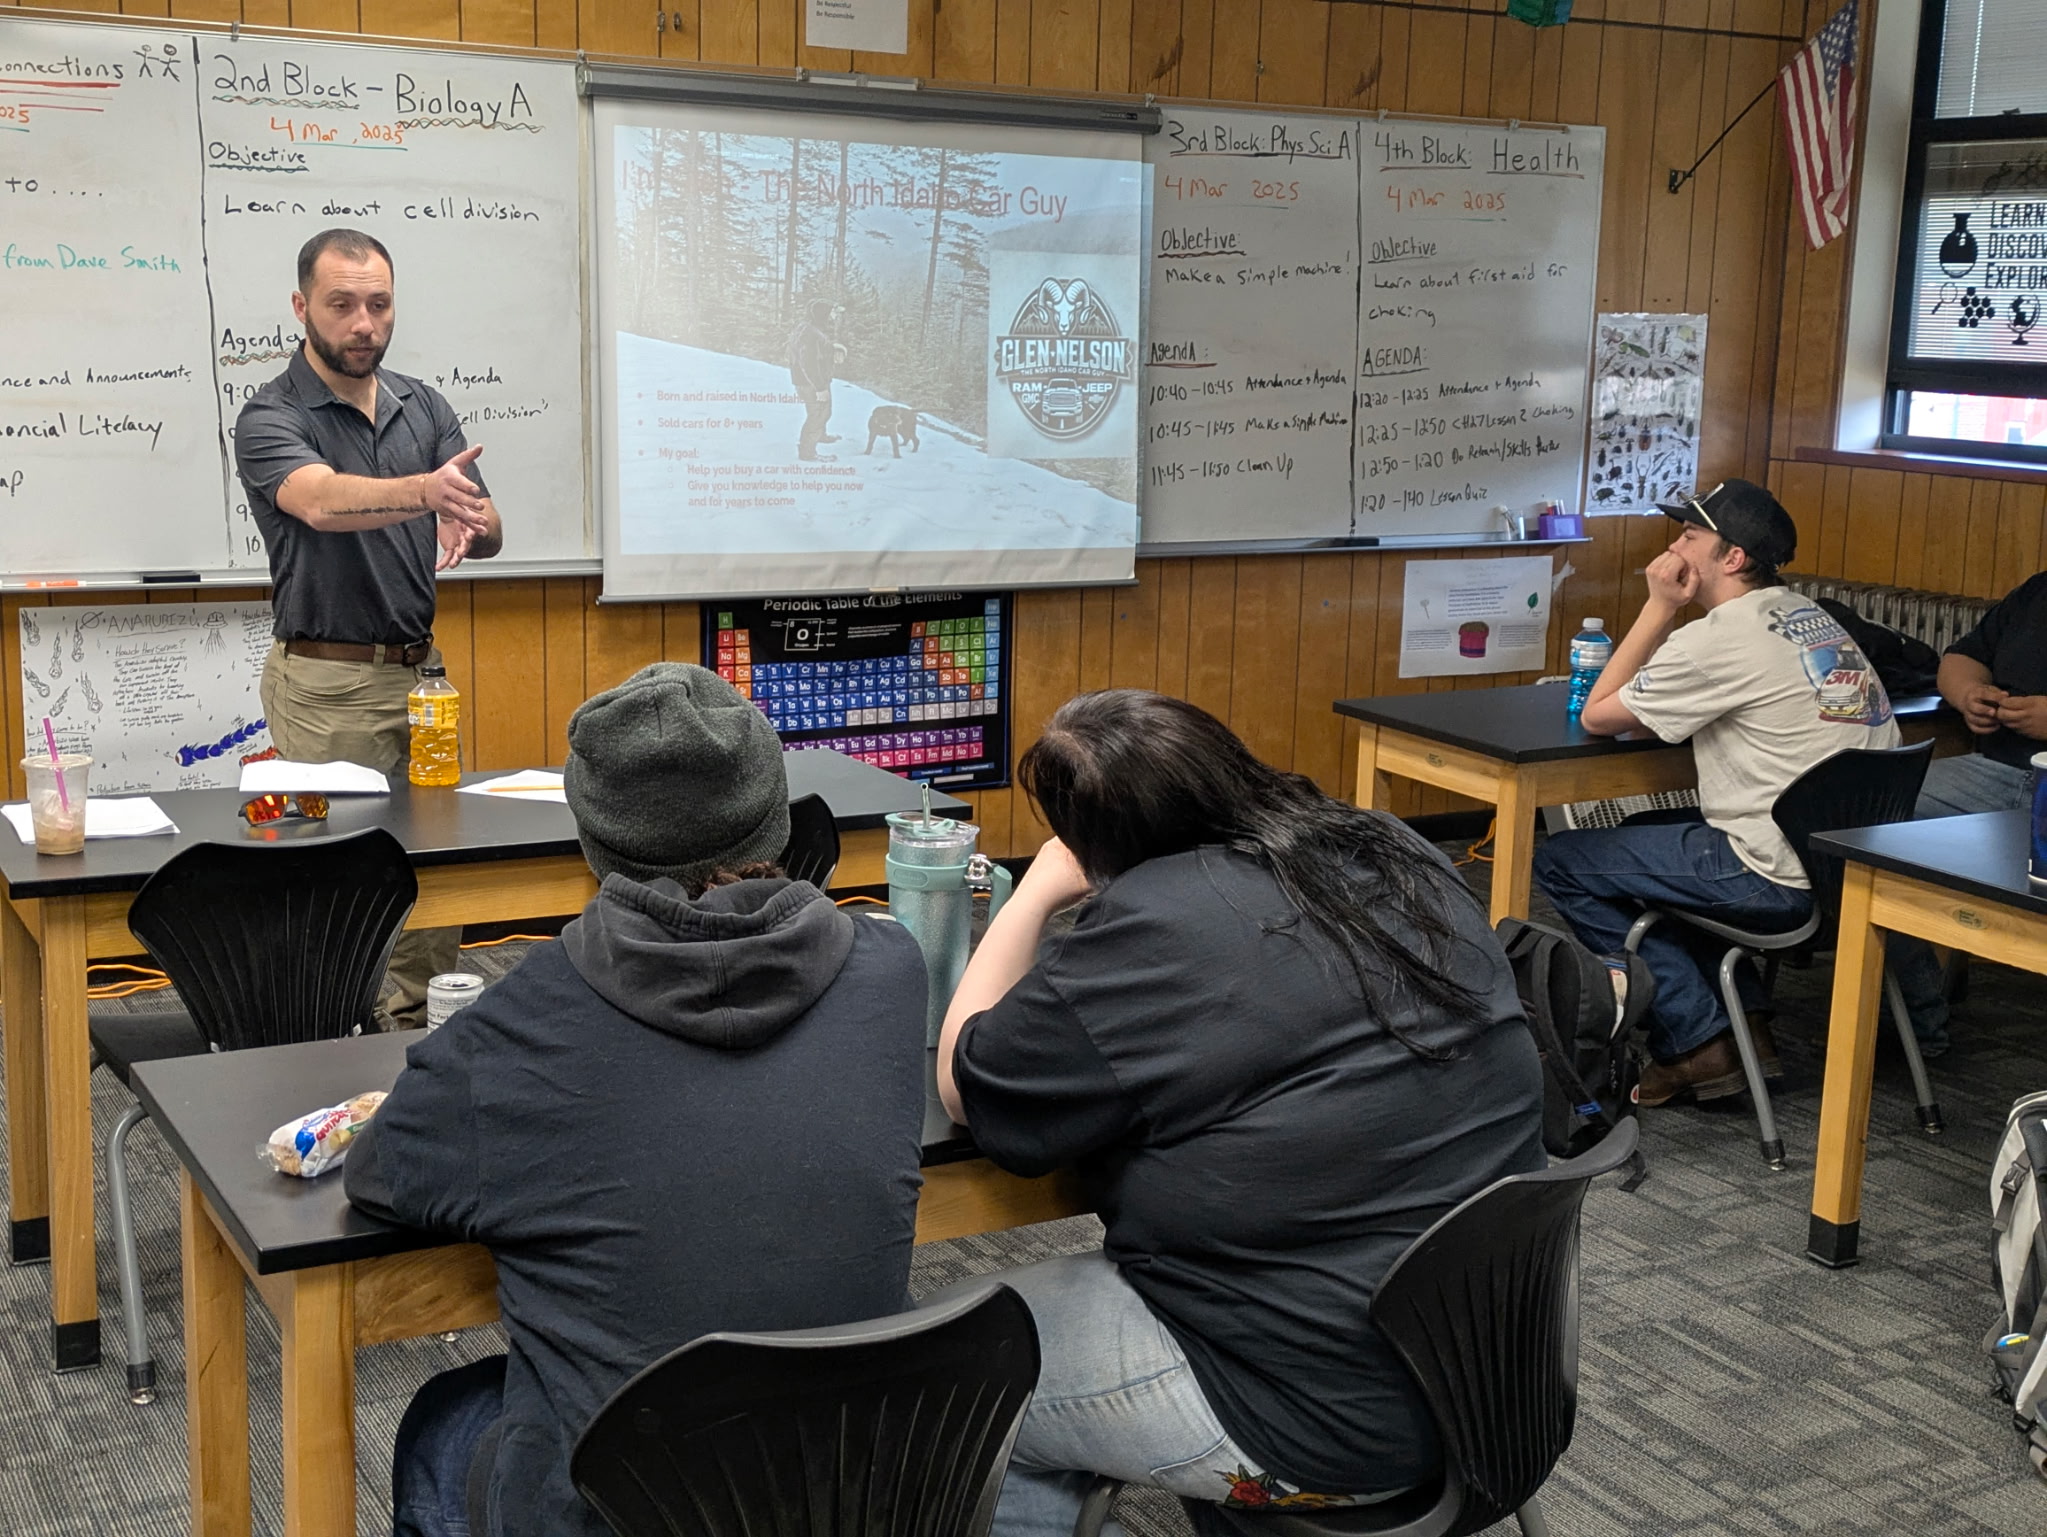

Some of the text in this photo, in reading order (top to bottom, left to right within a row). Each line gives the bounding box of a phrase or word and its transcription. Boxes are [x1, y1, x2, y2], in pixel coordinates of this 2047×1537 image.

[0, 55, 124, 79] onnections
[214, 54, 533, 129] 2nd Block Biology A
[270, 117, 294, 142] 4
[303, 123, 338, 143] Mar
[208, 141, 307, 165] Objective
[1168, 121, 1207, 154] 3rd
[1271, 125, 1304, 164] Phys
[1309, 131, 1332, 154] Sci
[1339, 131, 1351, 160] A
[1374, 132, 1413, 162] 4th
[1493, 138, 1579, 171] Health
[5, 177, 38, 193] to
[1165, 175, 1300, 201] 4 Mar 2025
[225, 194, 540, 221] Learn about cell division
[1020, 186, 1068, 223] Guy
[1388, 185, 1506, 212] 4 Mar 2025
[2, 243, 181, 273] from Dave Smith
[1374, 272, 1411, 290] Learn
[1420, 270, 1460, 289] about
[1512, 262, 1535, 281] aid
[1547, 263, 1568, 278] for
[39, 370, 71, 385] and
[452, 366, 503, 389] Agenda
[1013, 382, 1112, 393] RAM JEEP
[1150, 385, 1187, 406] 10:40
[1203, 381, 1234, 395] 10:45
[1314, 368, 1346, 388] Agenda
[657, 390, 680, 402] Born
[683, 391, 703, 402] and
[705, 391, 738, 402] raised
[739, 391, 748, 402] in
[750, 392, 777, 404] North
[1360, 392, 1388, 408] 12:20
[1402, 387, 1429, 405] 12:25
[1439, 382, 1489, 397] Attendance
[1505, 372, 1541, 391] Agenda
[0, 412, 66, 438] ancial
[658, 417, 680, 428] Sold
[682, 419, 704, 429] cars
[706, 418, 721, 429] for
[737, 419, 764, 430] years
[1150, 420, 1191, 443] 10:45
[1360, 422, 1398, 447] 12:25
[659, 447, 673, 460] My
[687, 464, 710, 476] Help
[712, 466, 731, 477] you
[734, 464, 753, 476] buy
[755, 466, 762, 474] a
[764, 466, 779, 474] car
[780, 464, 802, 474] with
[1362, 456, 1398, 480] 12:50
[687, 480, 864, 493] Give you knowledge to help you now
[688, 496, 707, 506] and
[724, 498, 750, 509] years
[754, 496, 765, 506] to
[767, 497, 796, 506] come
[763, 599, 821, 611] Periodic
[826, 597, 860, 610] Table
[1825, 671, 1861, 685] 3M
